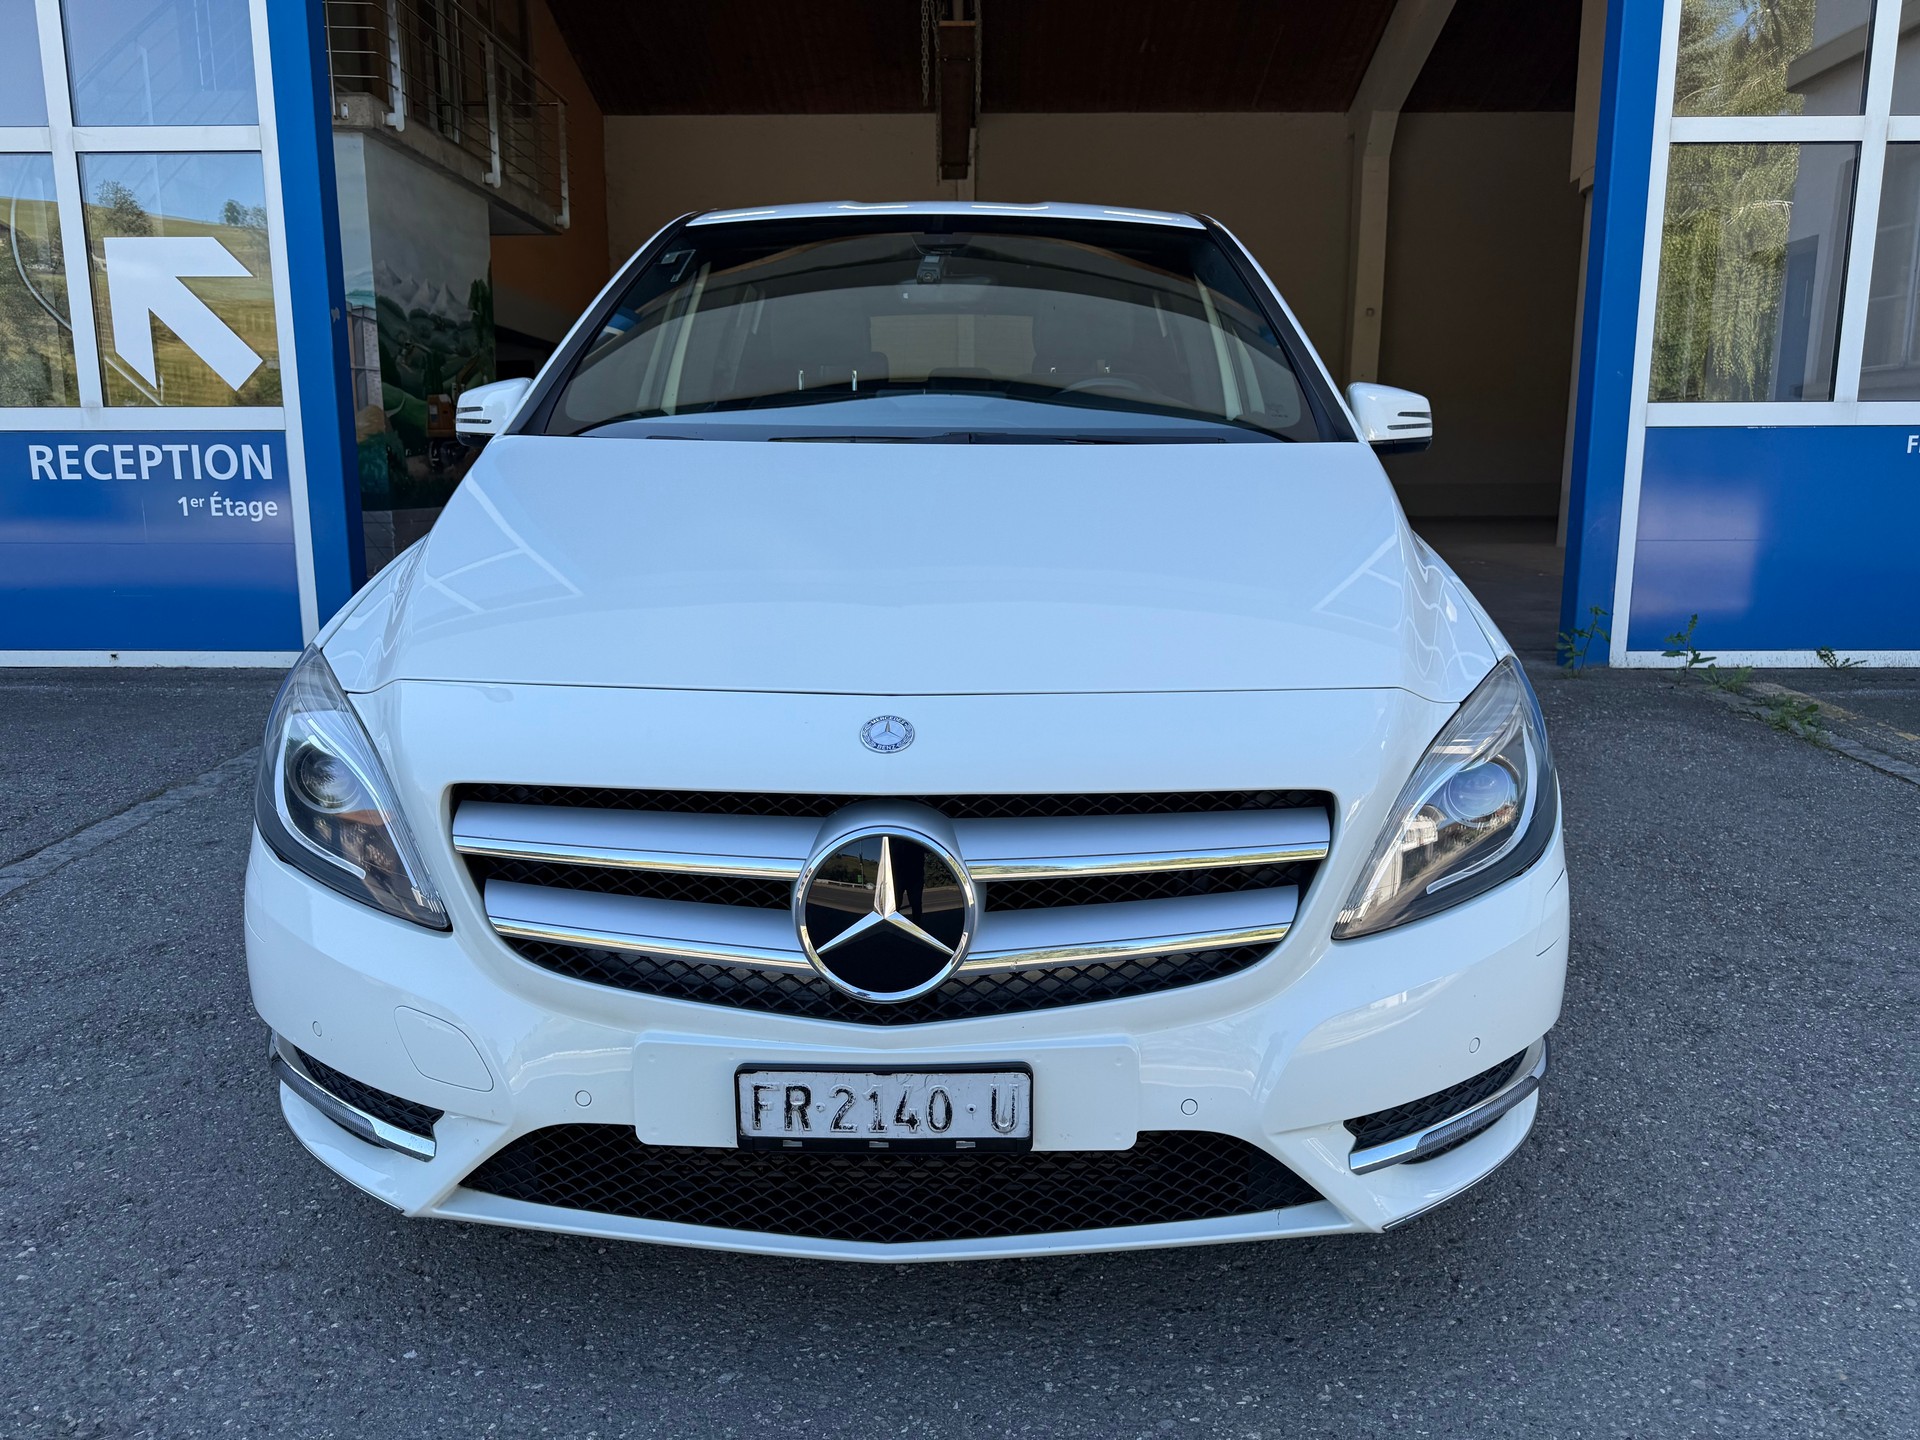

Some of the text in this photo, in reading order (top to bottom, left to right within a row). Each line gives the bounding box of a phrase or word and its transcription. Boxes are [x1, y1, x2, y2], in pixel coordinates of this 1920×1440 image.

[1907, 435, 1920, 453] F
[28, 444, 273, 480] RECEPTION
[177, 491, 278, 522] 1er Étage
[751, 1082, 1020, 1133] FR 2140 U
